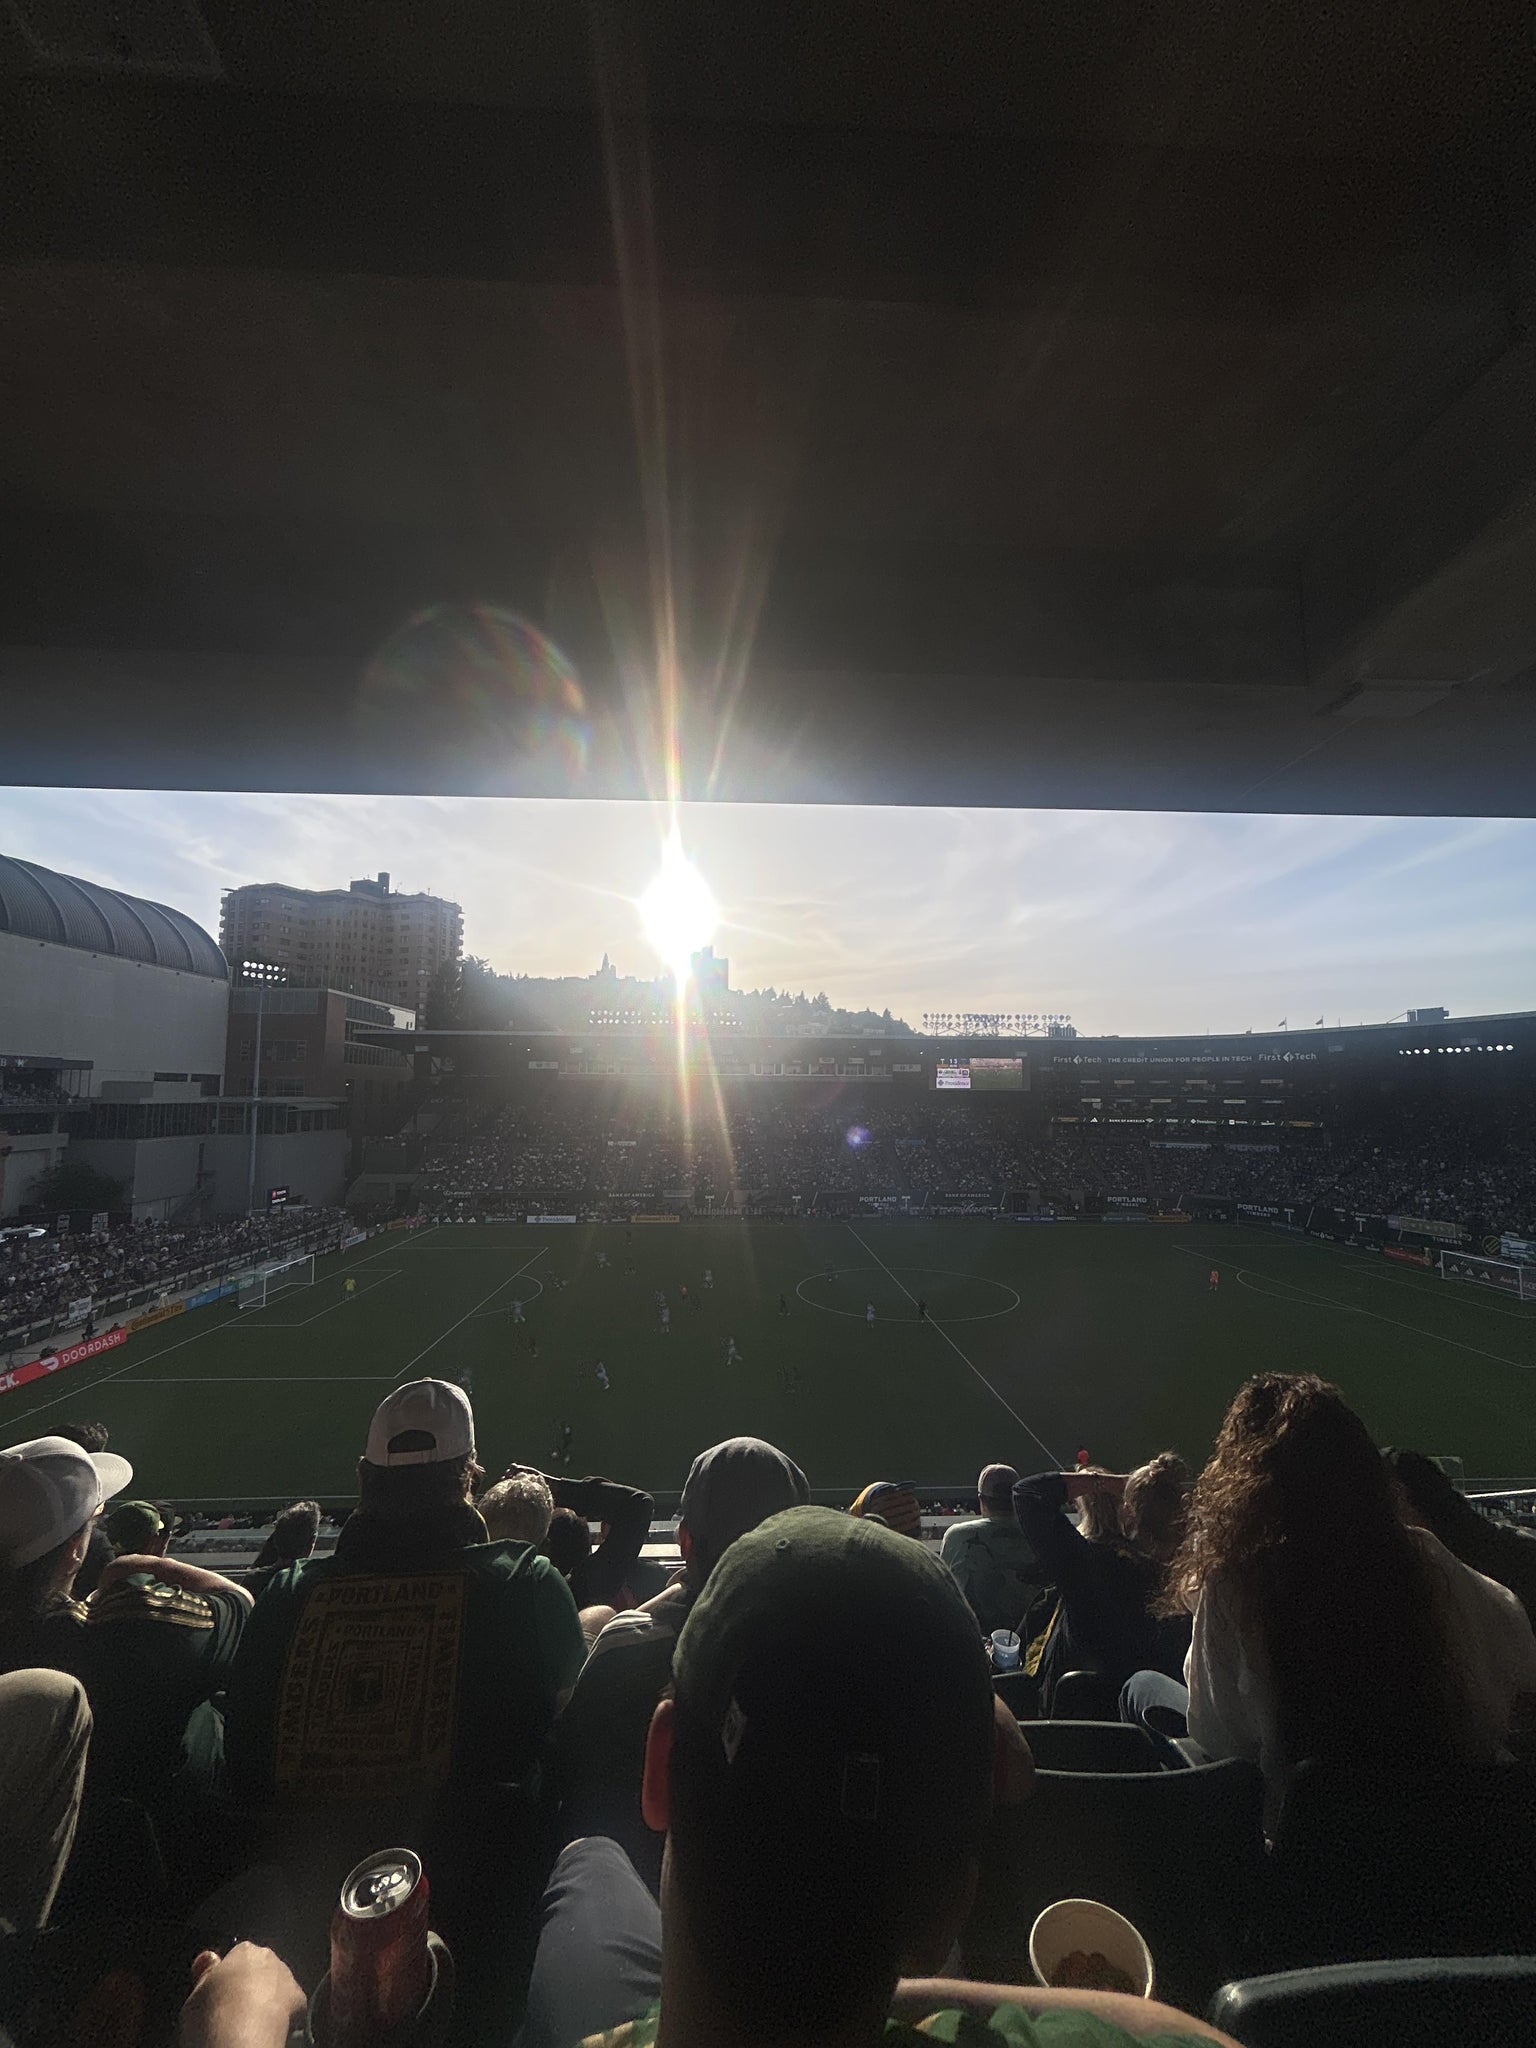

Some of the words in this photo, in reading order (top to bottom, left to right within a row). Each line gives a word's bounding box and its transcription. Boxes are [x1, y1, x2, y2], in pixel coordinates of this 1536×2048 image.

[1294, 1052, 1316, 1061] Tech
[1237, 1203, 1279, 1214] PORTLAND
[62, 1333, 121, 1364] DOORDASH
[329, 1581, 441, 1606] PORTLAND
[344, 1624, 416, 1638] PORTLAND
